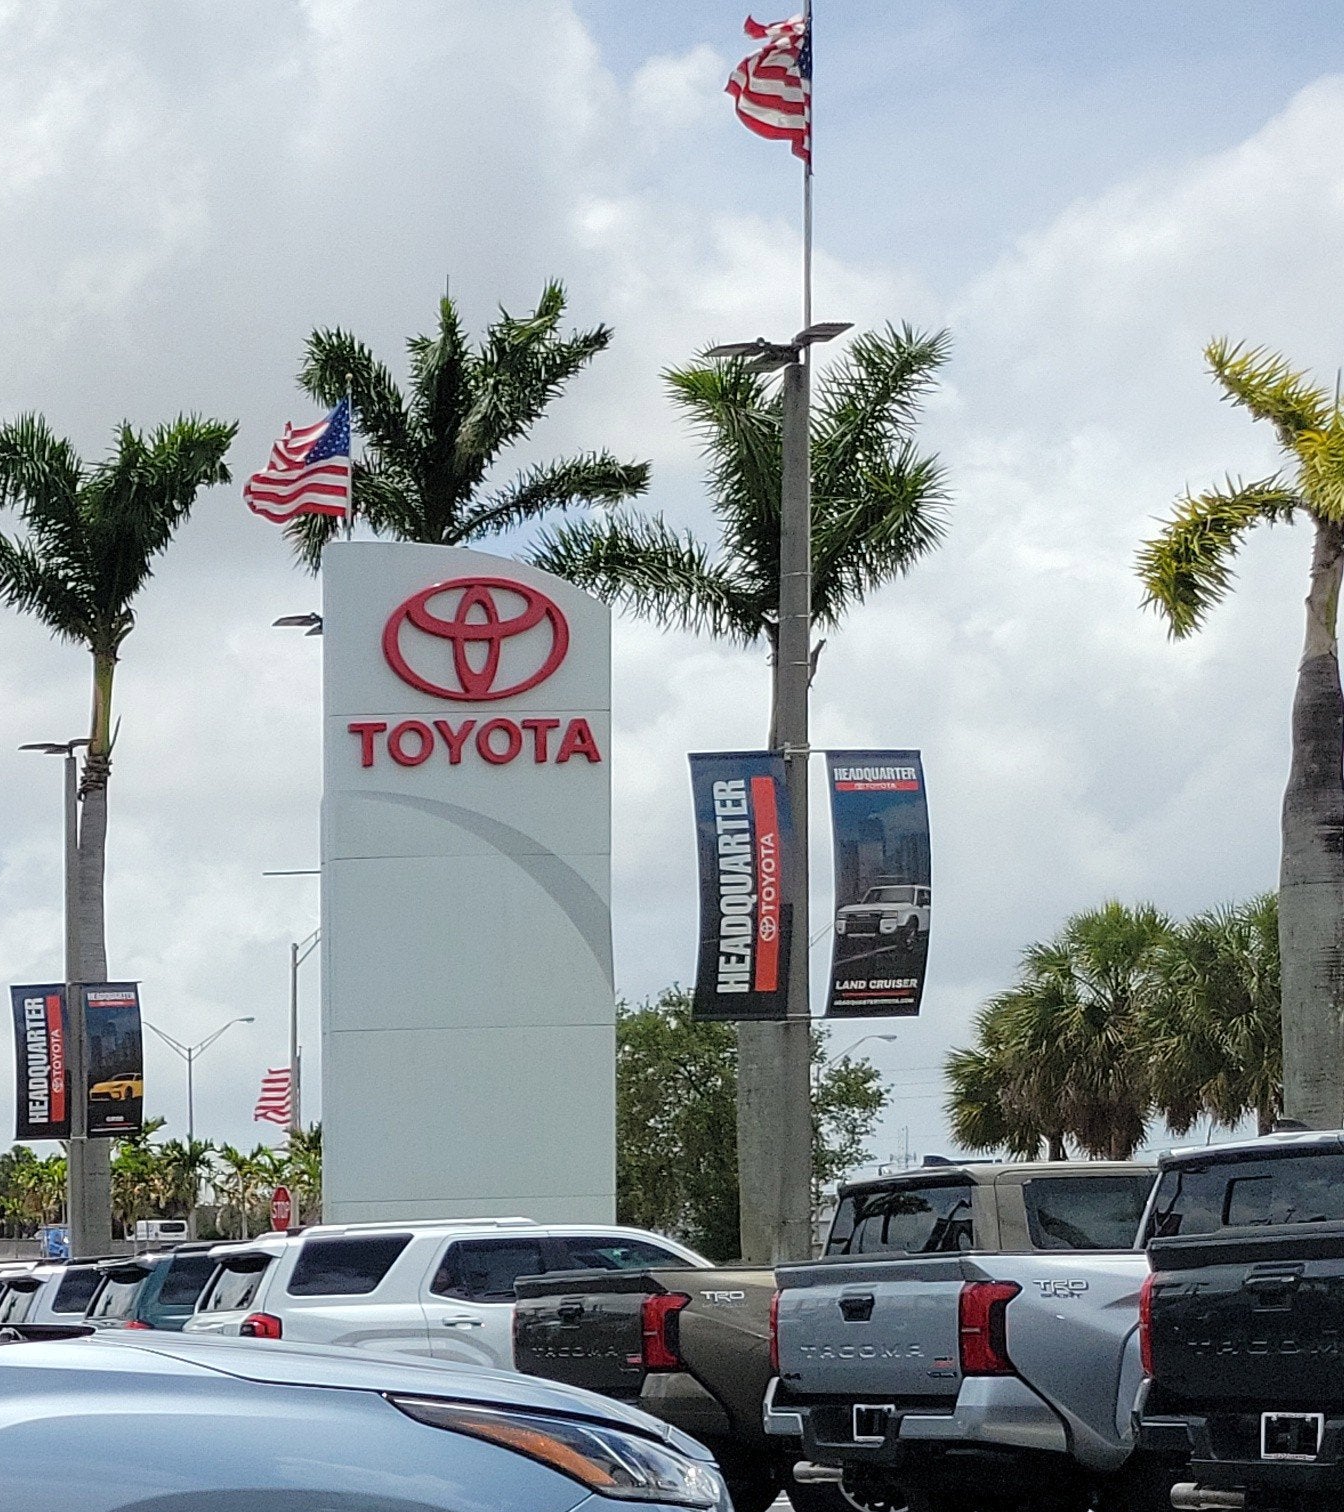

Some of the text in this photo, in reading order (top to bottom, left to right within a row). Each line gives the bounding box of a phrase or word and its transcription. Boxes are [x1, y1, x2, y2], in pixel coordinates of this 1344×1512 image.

[347, 717, 602, 768] TOYOTA
[833, 767, 917, 782] HEADQUARTER
[761, 832, 777, 914] TOYOTA
[712, 779, 758, 994] HEADQUARTER
[835, 978, 918, 990] LAND CRUISER
[24, 997, 51, 1124] HEADQUARTER
[51, 1028, 63, 1079] TOYOTA
[272, 1201, 290, 1219] STOP
[1032, 1279, 1090, 1293] TRD
[700, 1290, 745, 1303] TRD
[530, 1345, 618, 1358] TACOMA
[800, 1343, 925, 1359] TACOMA
